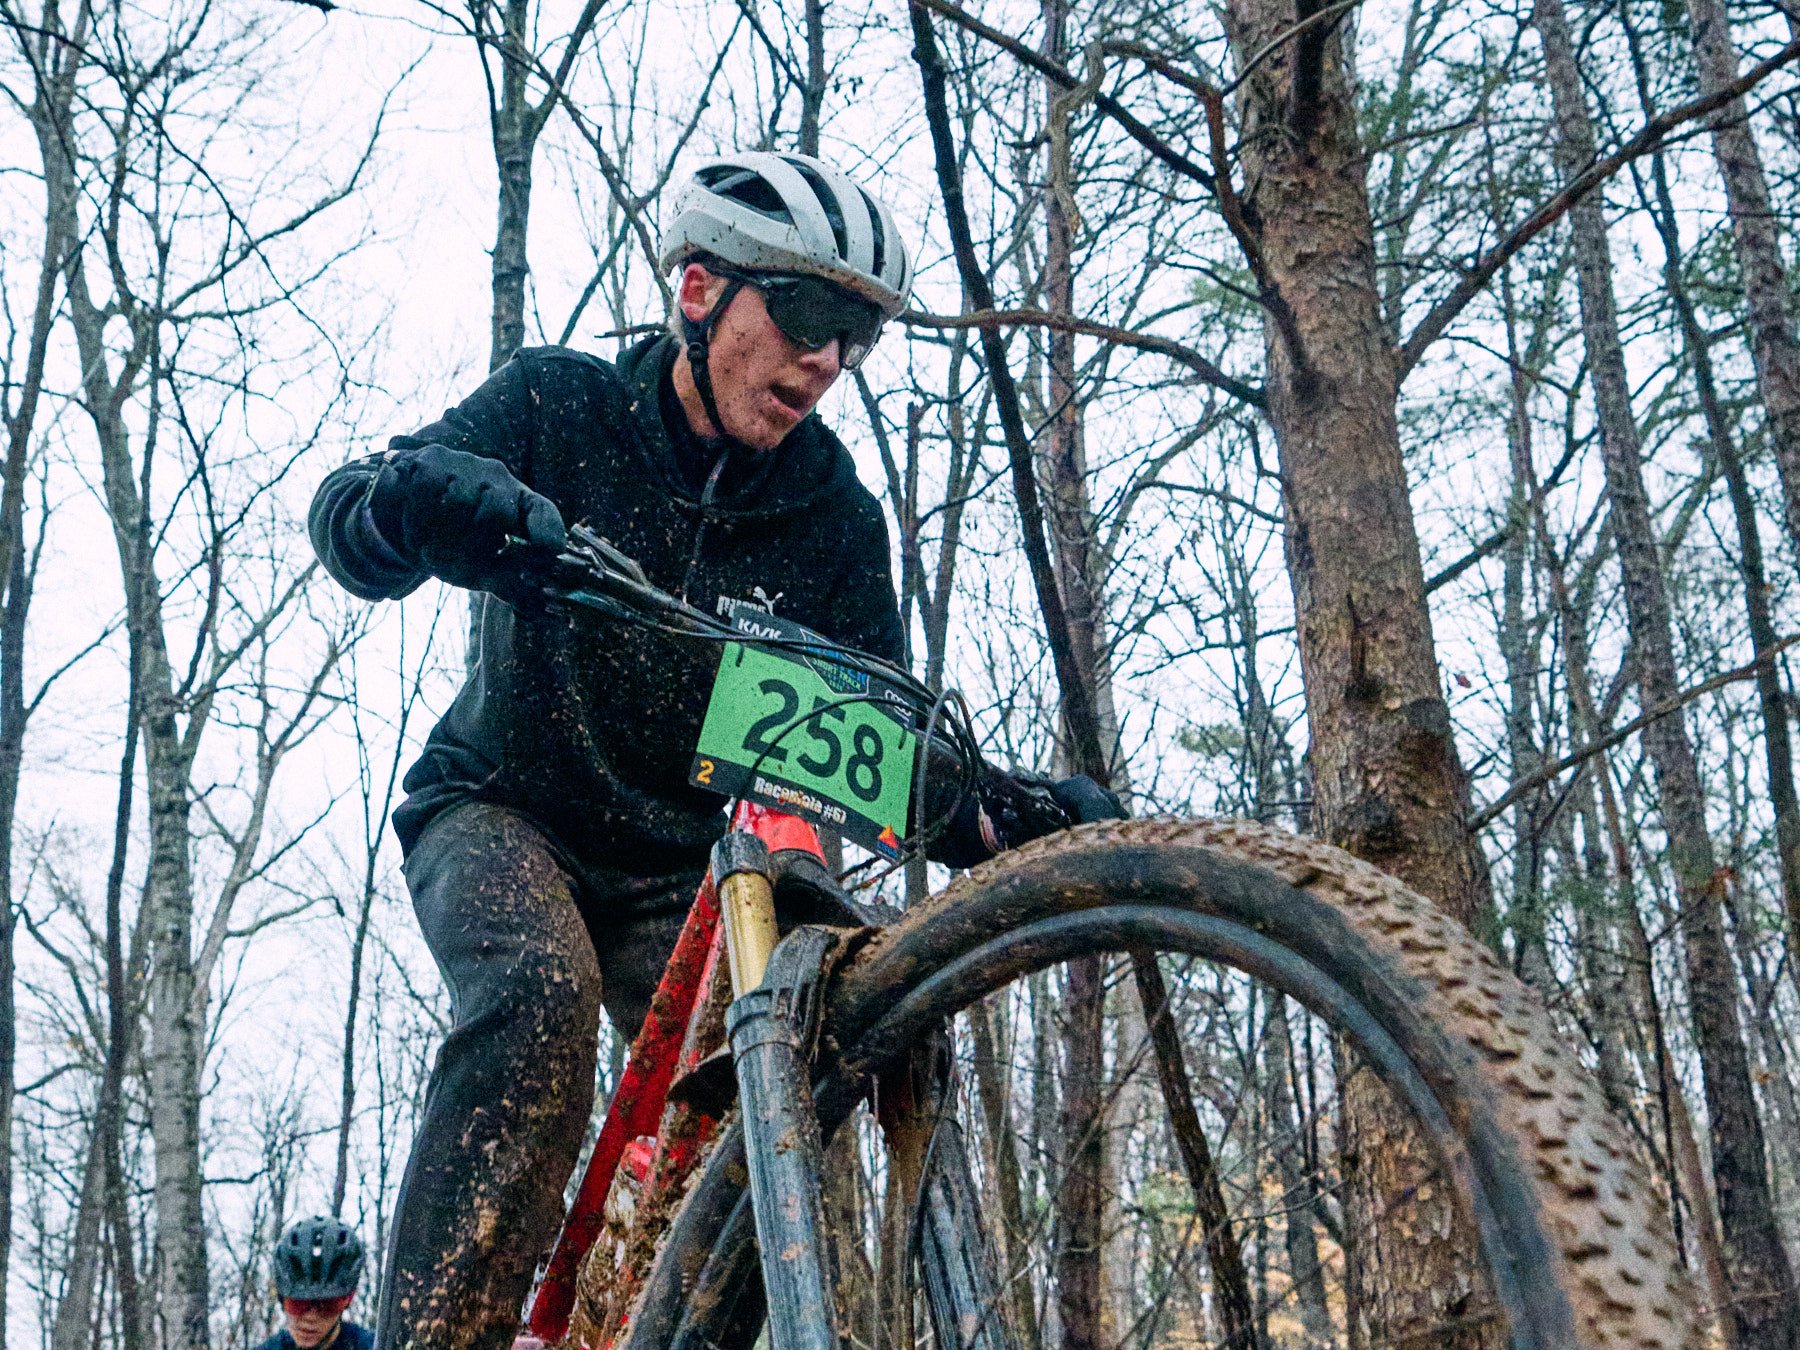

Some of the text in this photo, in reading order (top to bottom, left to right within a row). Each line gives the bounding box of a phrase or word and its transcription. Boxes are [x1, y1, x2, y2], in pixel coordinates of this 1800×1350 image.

[738, 618, 782, 639] KASK
[742, 678, 884, 803] 258
[696, 760, 715, 785] 2
